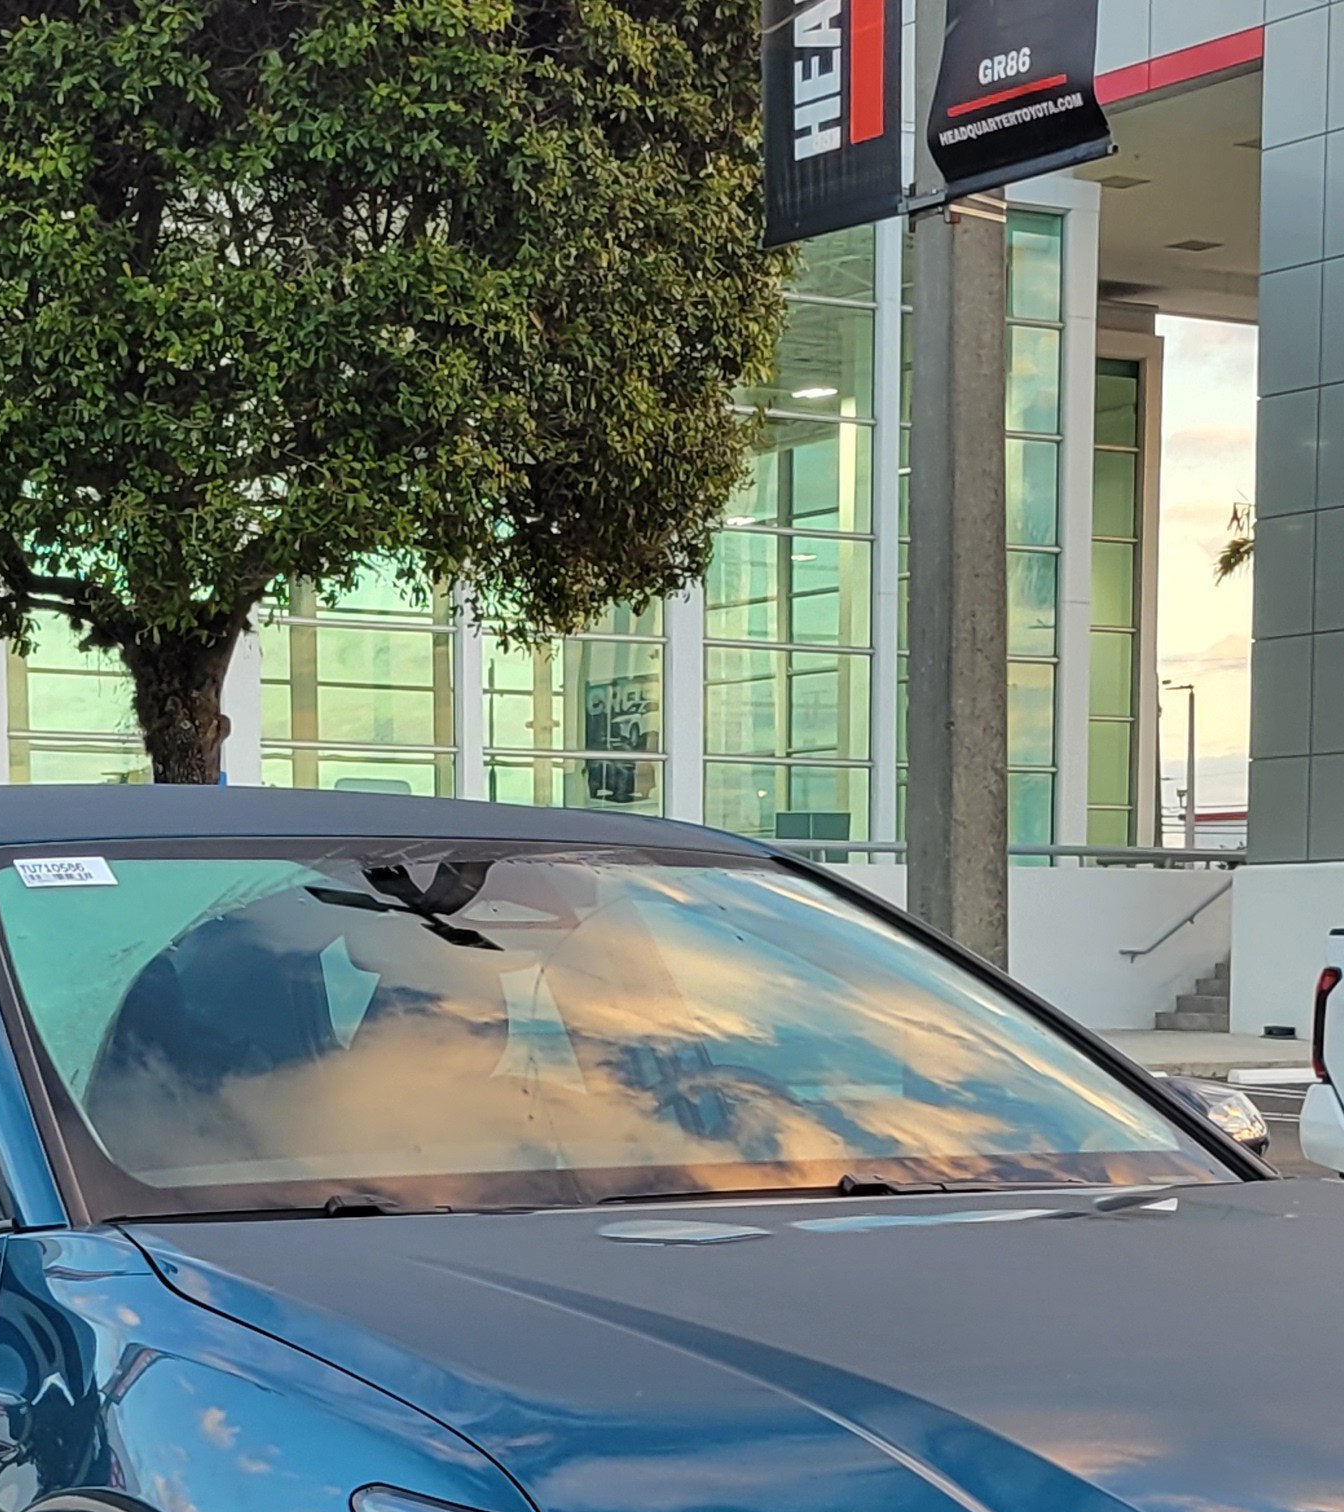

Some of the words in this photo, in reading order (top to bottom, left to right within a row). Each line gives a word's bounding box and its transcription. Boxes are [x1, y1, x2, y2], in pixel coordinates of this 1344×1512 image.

[794, 0, 841, 161] HEA
[978, 46, 1031, 85] GR86
[939, 92, 1084, 146] HEADQUARTERTOYOTA.COM
